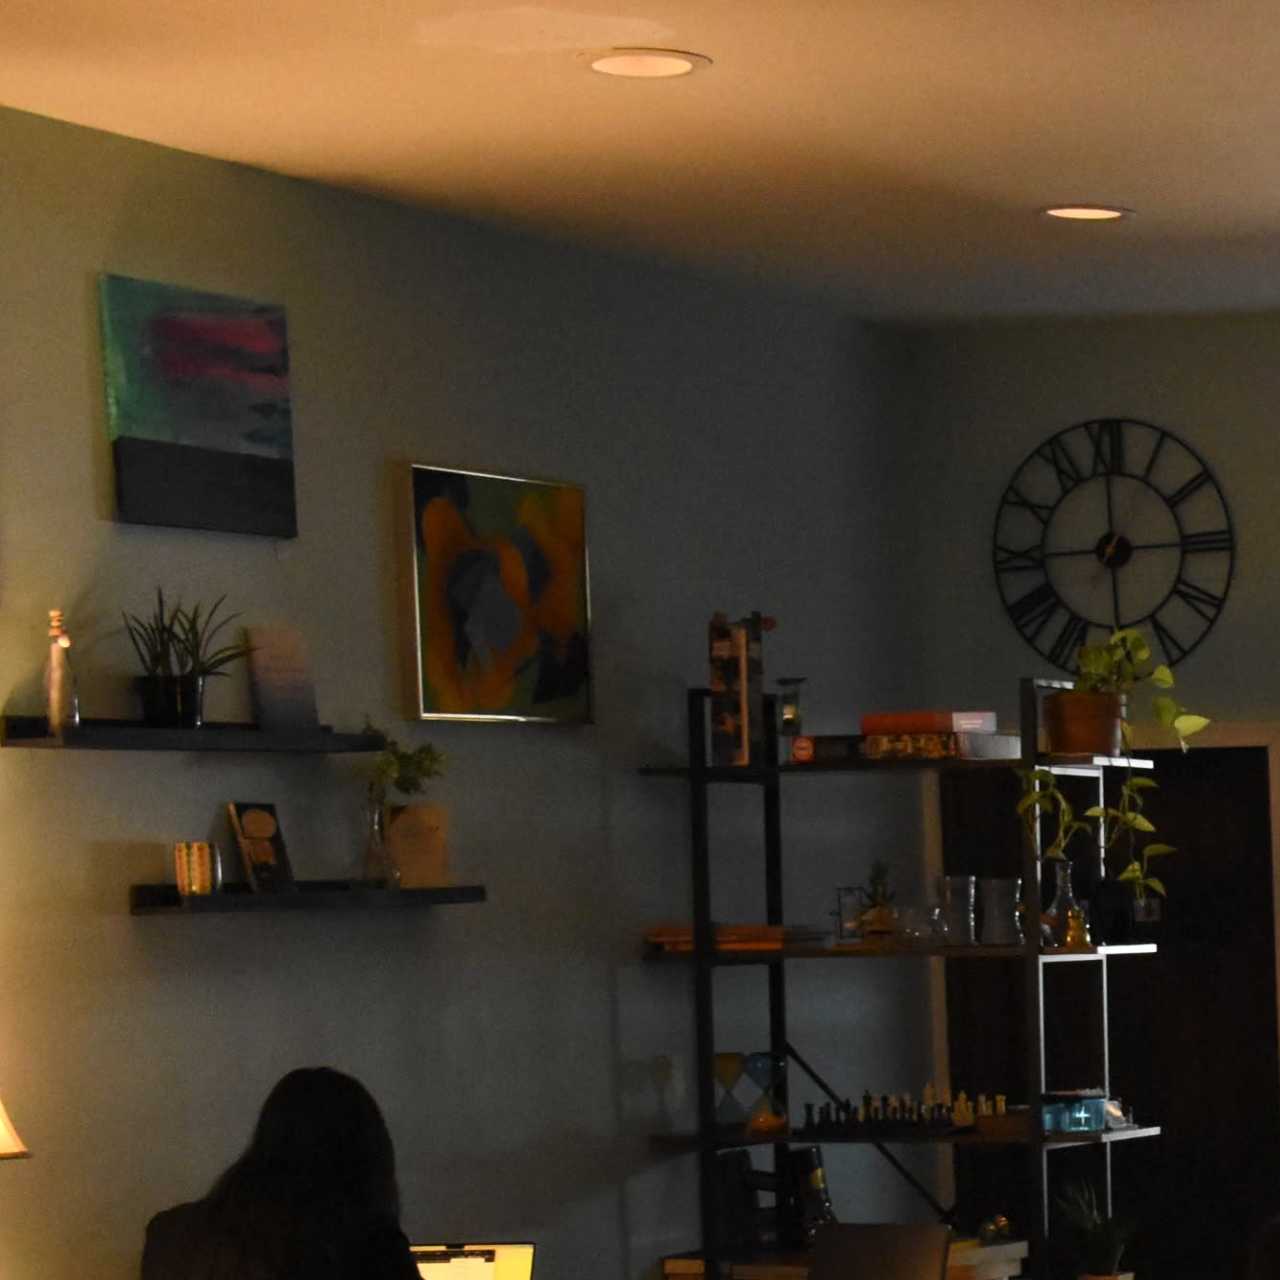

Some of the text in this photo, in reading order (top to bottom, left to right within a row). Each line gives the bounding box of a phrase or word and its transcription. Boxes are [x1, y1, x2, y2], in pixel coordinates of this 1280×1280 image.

[1036, 437, 1083, 493] XI
[1085, 420, 1123, 475] XII
[1145, 431, 1168, 478] I
[1003, 486, 1055, 527] X
[1165, 469, 1212, 509] II
[995, 545, 1045, 574] IX
[1181, 530, 1234, 553] III
[1151, 614, 1188, 666] V
